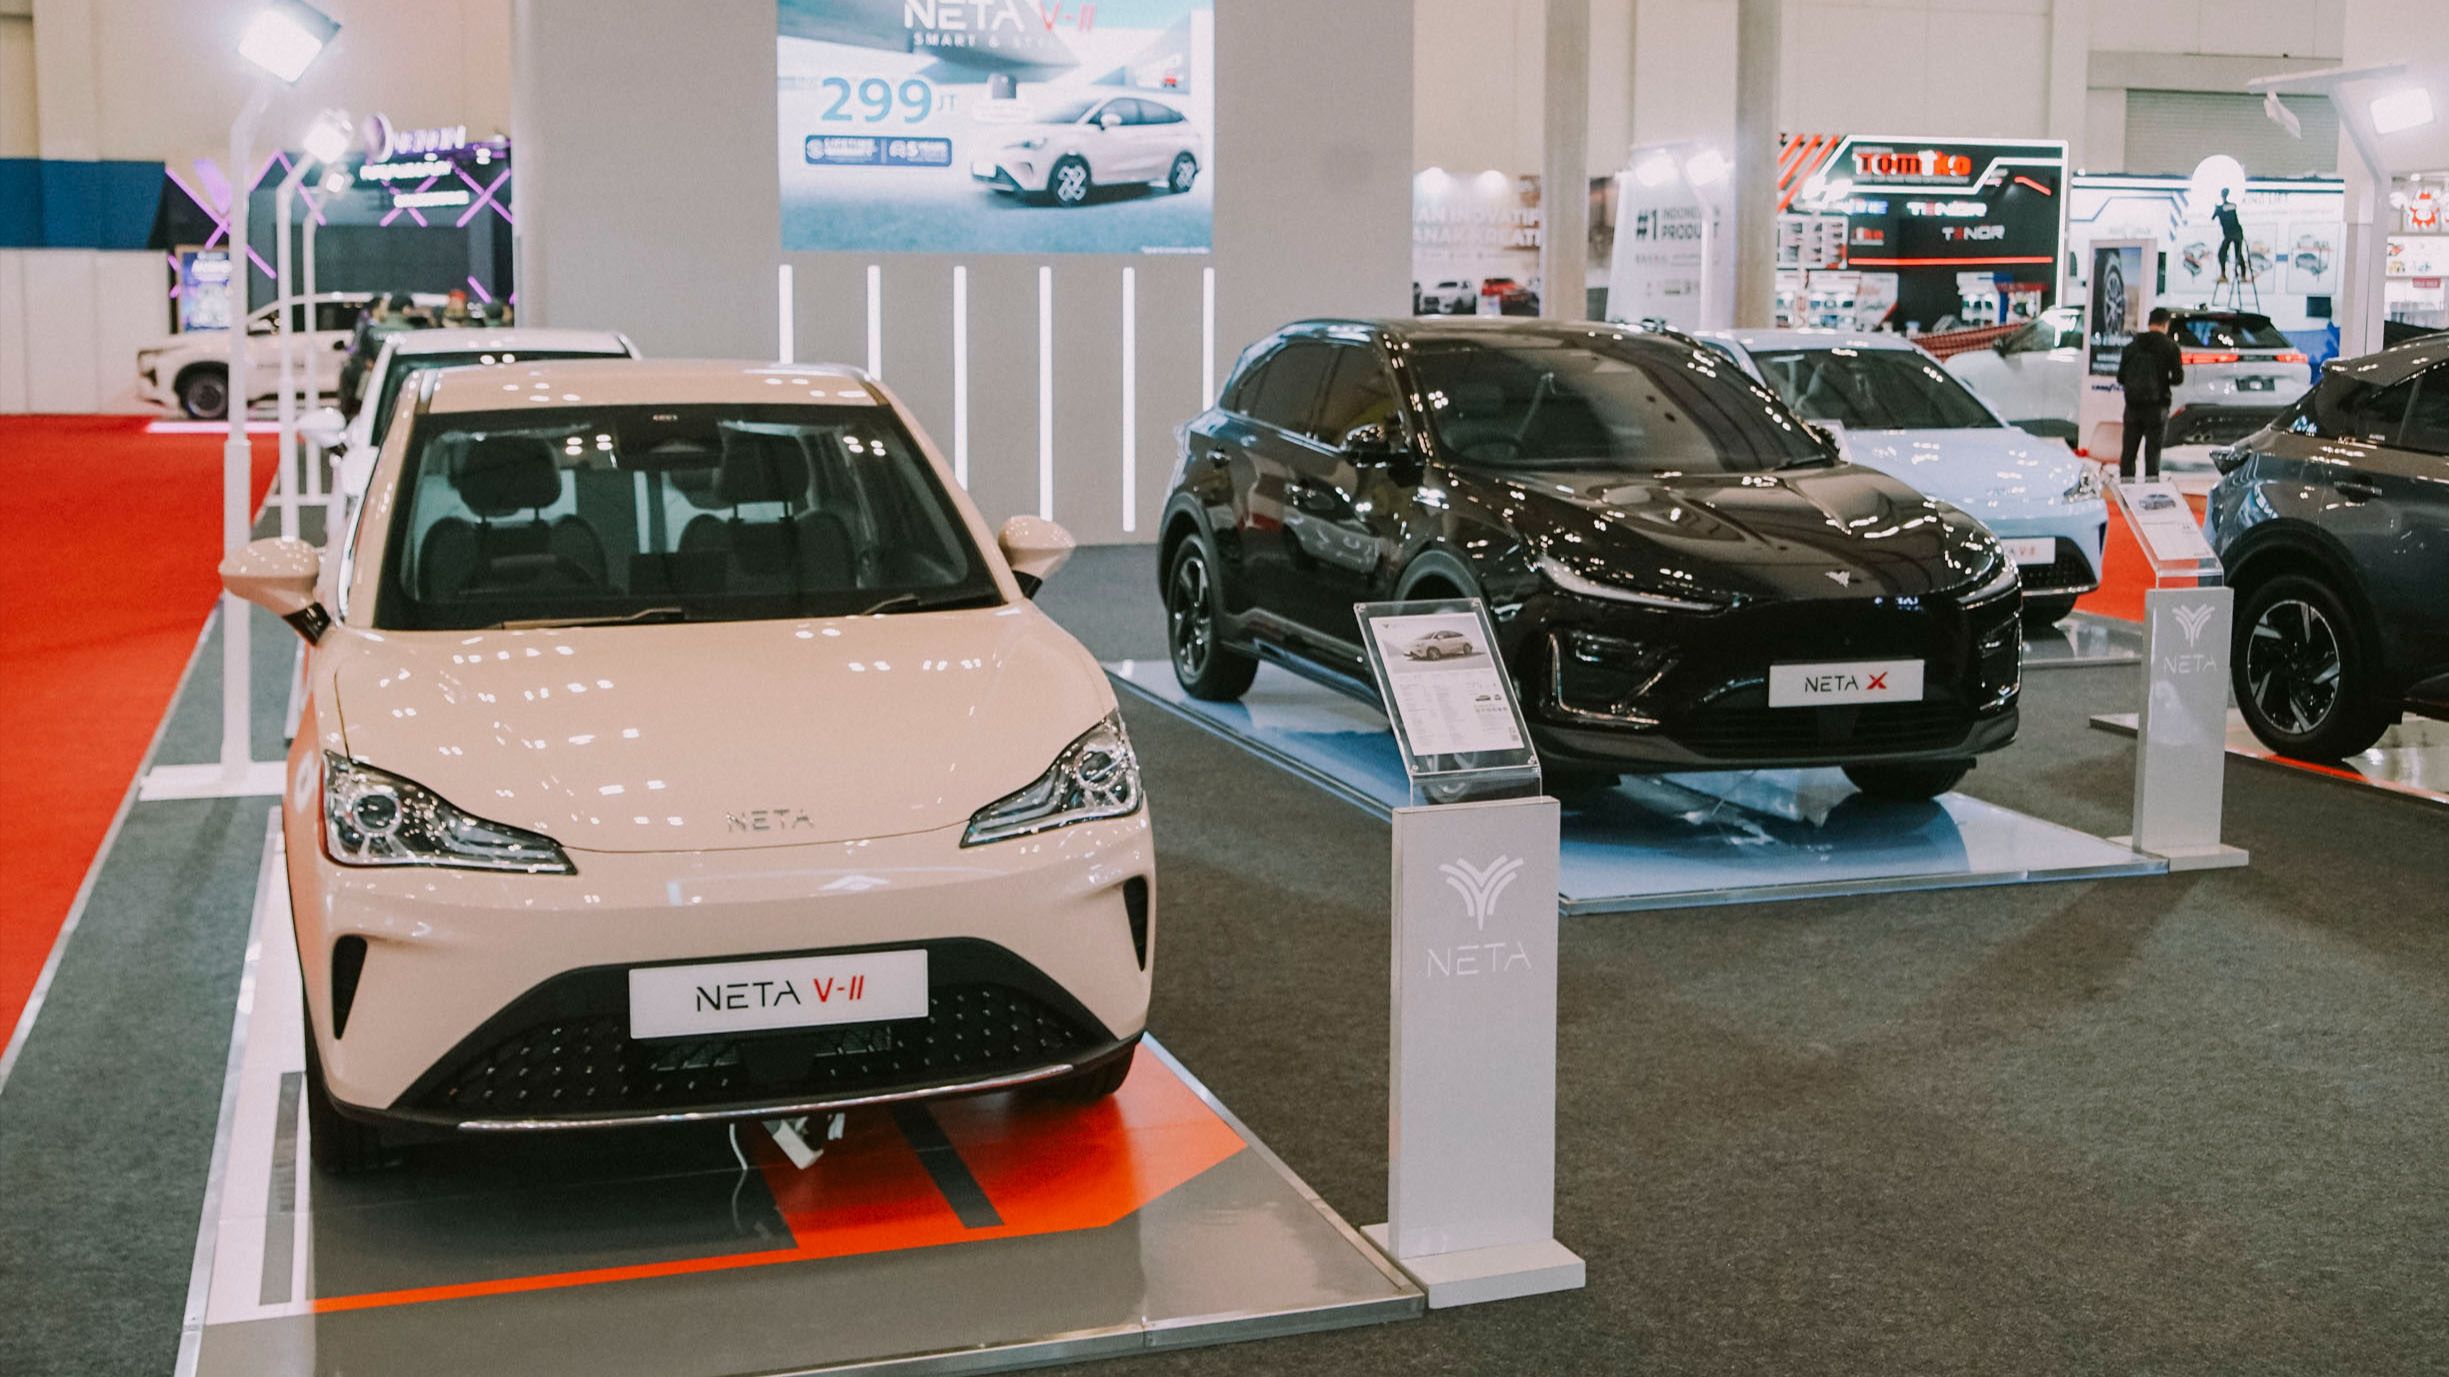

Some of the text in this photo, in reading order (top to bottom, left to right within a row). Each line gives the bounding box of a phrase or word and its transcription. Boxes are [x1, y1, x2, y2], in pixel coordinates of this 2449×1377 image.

[904, 0, 1025, 31] NETA
[912, 32, 977, 48] SMART
[820, 76, 933, 124] 299
[1636, 207, 1658, 241] #1
[1661, 223, 1720, 240] PRODUT
[2162, 652, 2218, 675] NETA
[1804, 671, 1888, 693] NETA X
[725, 807, 815, 833] NETA
[1427, 941, 1533, 978] NETA
[696, 974, 865, 1013] NETA V-II
